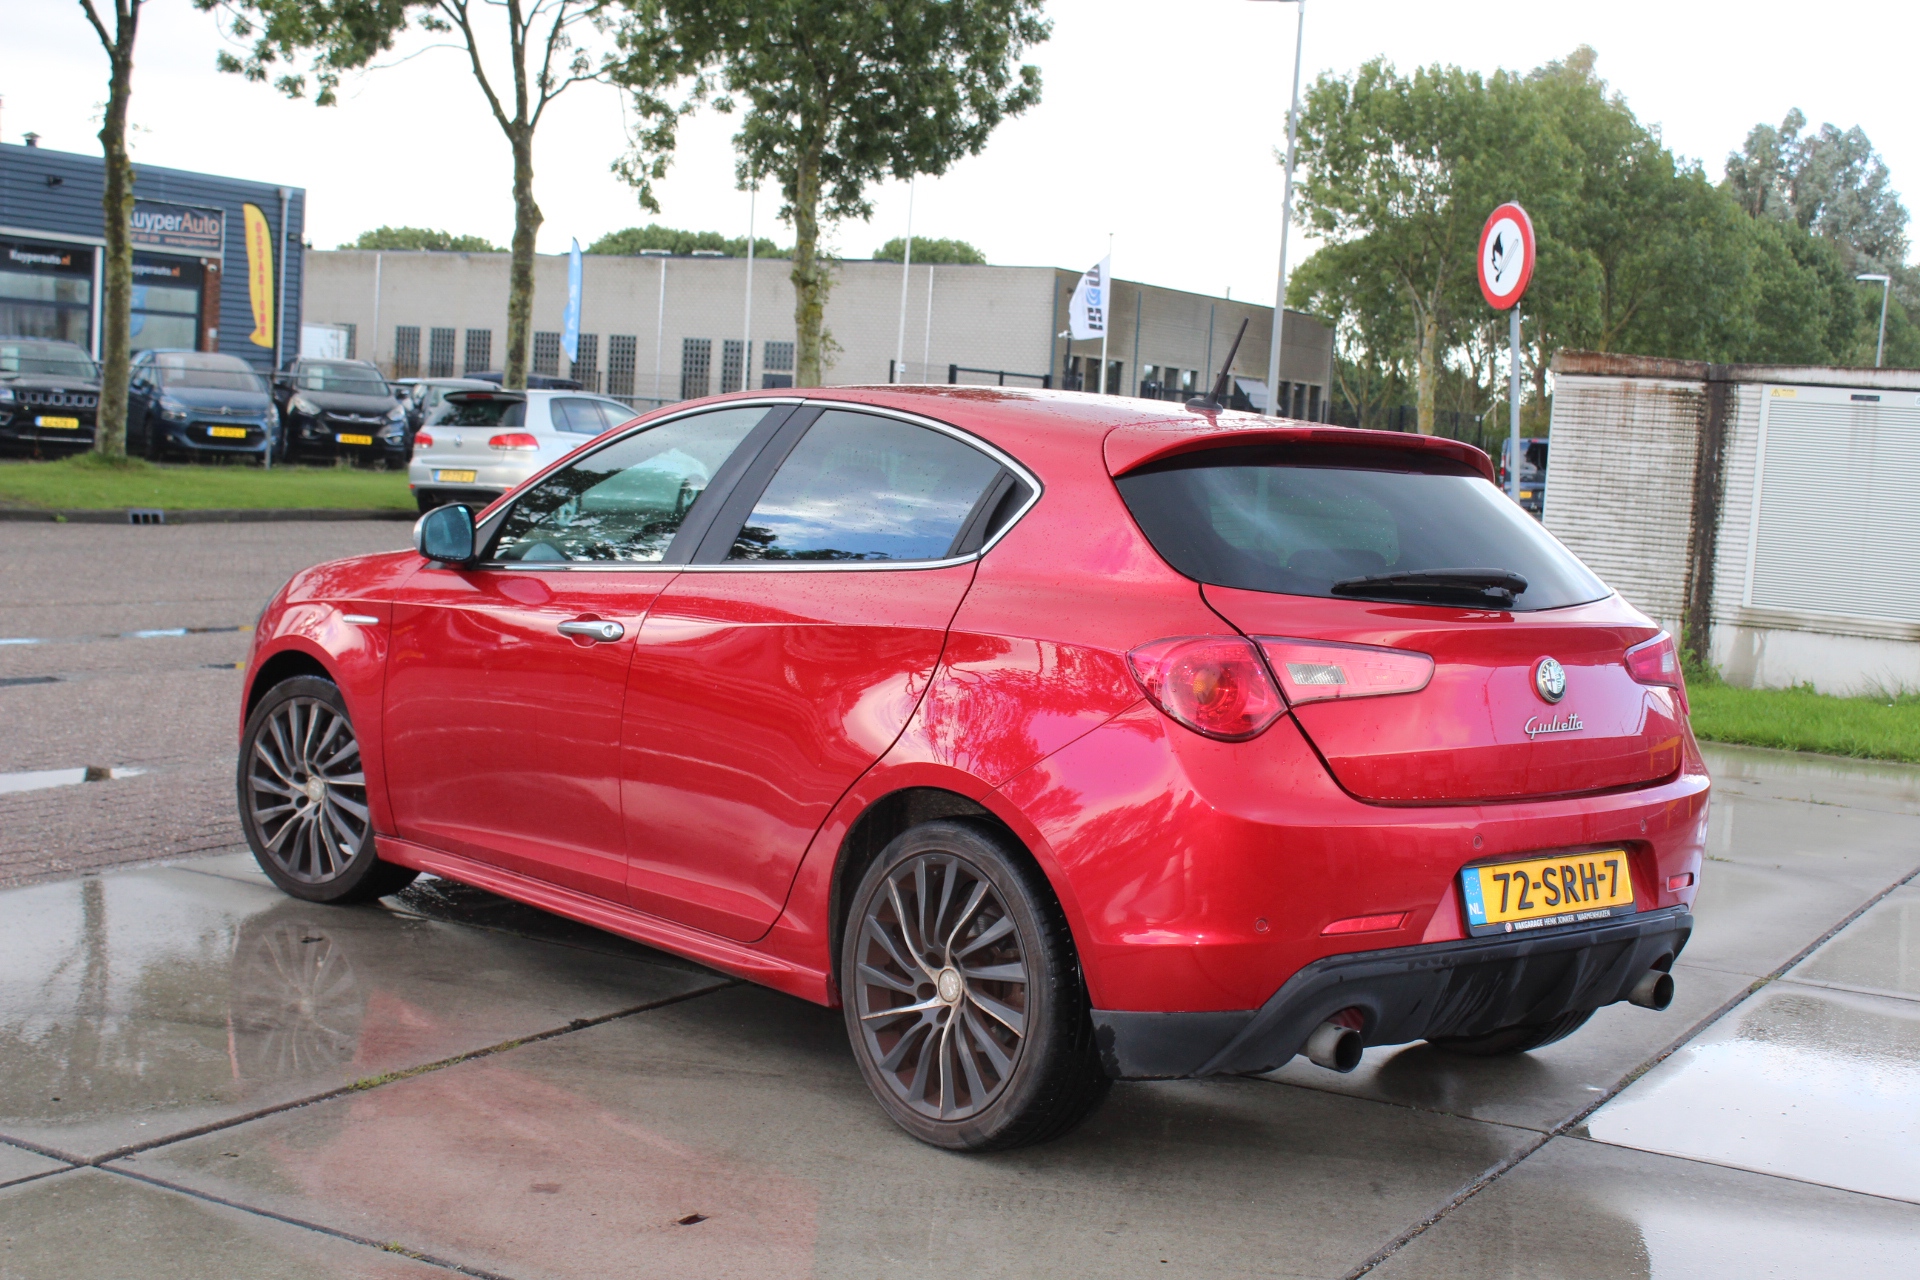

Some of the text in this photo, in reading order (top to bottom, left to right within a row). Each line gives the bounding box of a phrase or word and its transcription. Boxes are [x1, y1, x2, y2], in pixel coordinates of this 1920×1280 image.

[1524, 713, 1583, 740] Giulietta
[1493, 859, 1619, 913] 72-SRH-7
[1468, 903, 1483, 916] NL
[1514, 918, 1544, 930] VAKGARAGE
[1543, 917, 1557, 926] HENK
